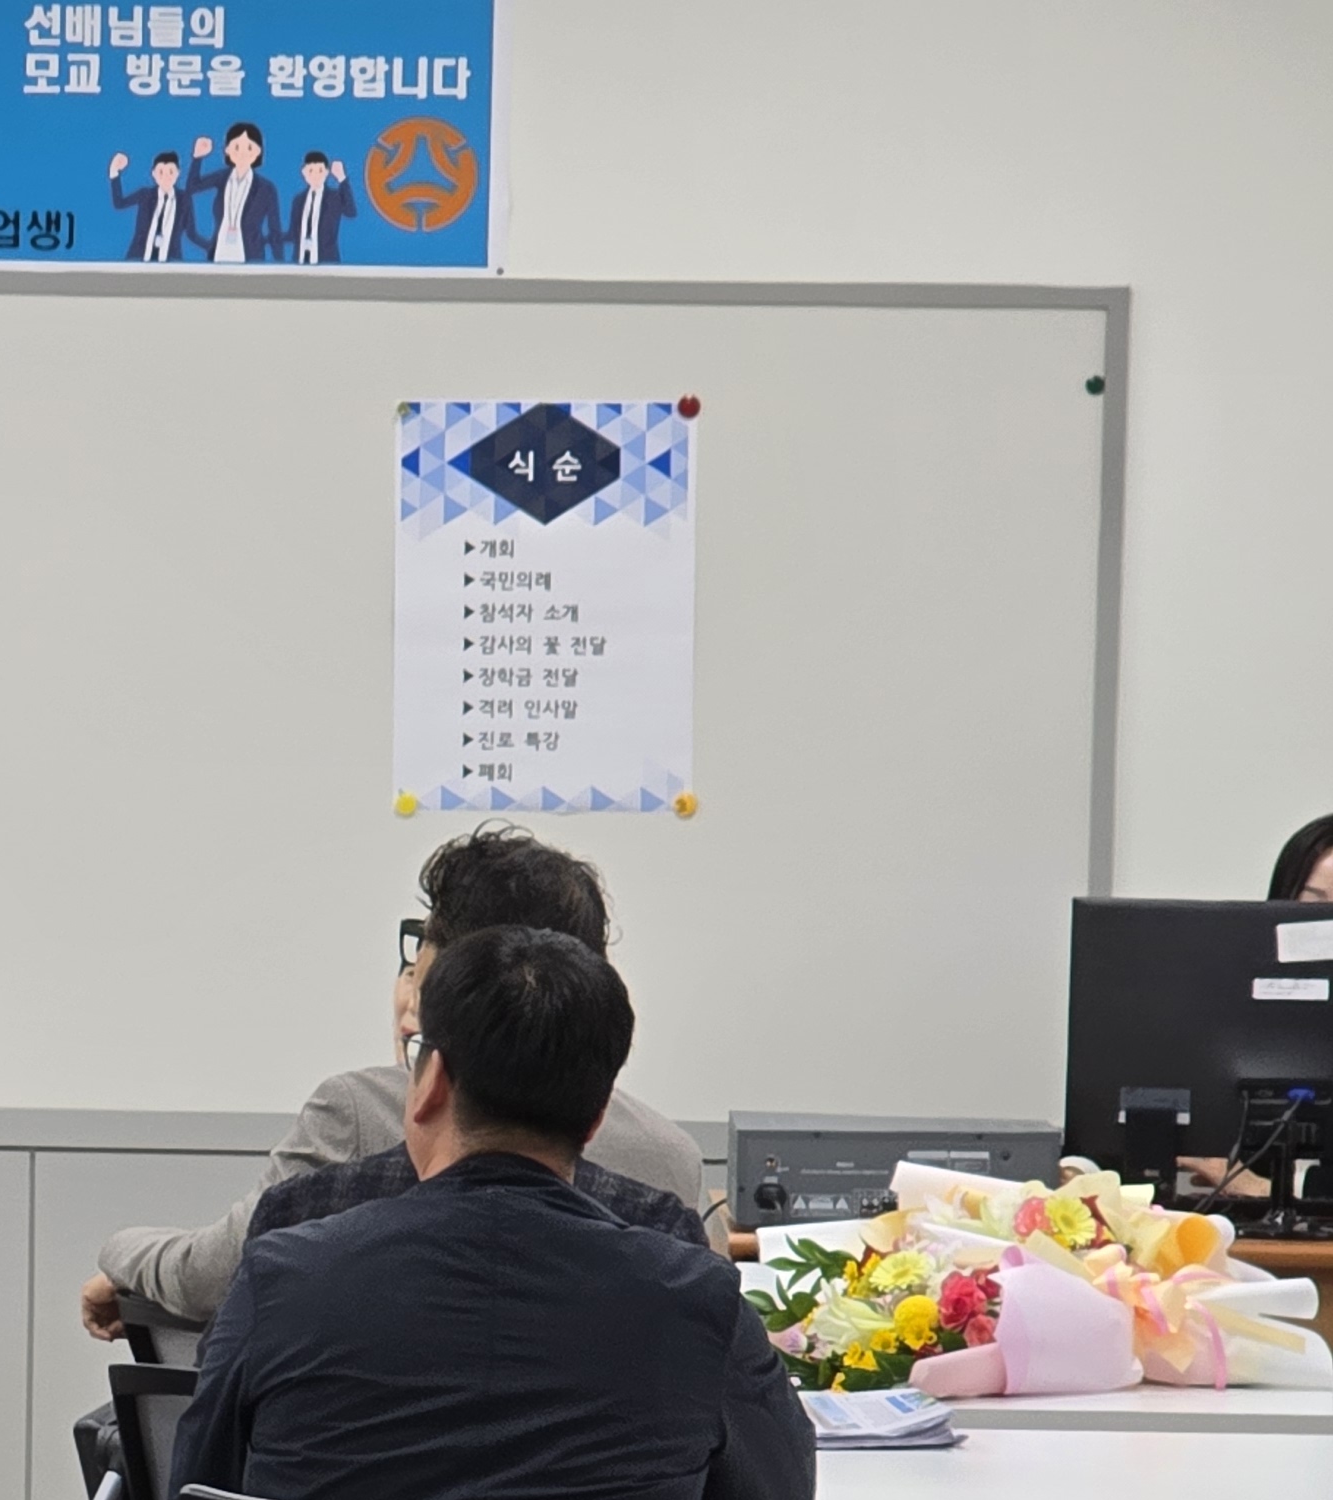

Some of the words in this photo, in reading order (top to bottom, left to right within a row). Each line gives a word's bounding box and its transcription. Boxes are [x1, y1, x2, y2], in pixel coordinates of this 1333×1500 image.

[23, 4, 225, 48] 선배님들의
[23, 53, 101, 94] 모교
[126, 54, 245, 96] 방문을
[268, 54, 470, 100] 환영합니다
[480, 540, 515, 558] 개회
[480, 572, 552, 591] 국민의례
[479, 604, 532, 623] 참석자
[543, 604, 579, 623] 소개
[479, 636, 532, 655] 감사의
[543, 636, 560, 656] 꽃
[570, 636, 606, 656] 전달
[479, 668, 532, 687] 장학금
[542, 668, 578, 687] 전달
[478, 699, 513, 719] 격려
[524, 699, 578, 719] 인사말
[478, 732, 514, 751] 진로
[524, 732, 559, 751] 특강
[478, 763, 512, 782] 폐회
